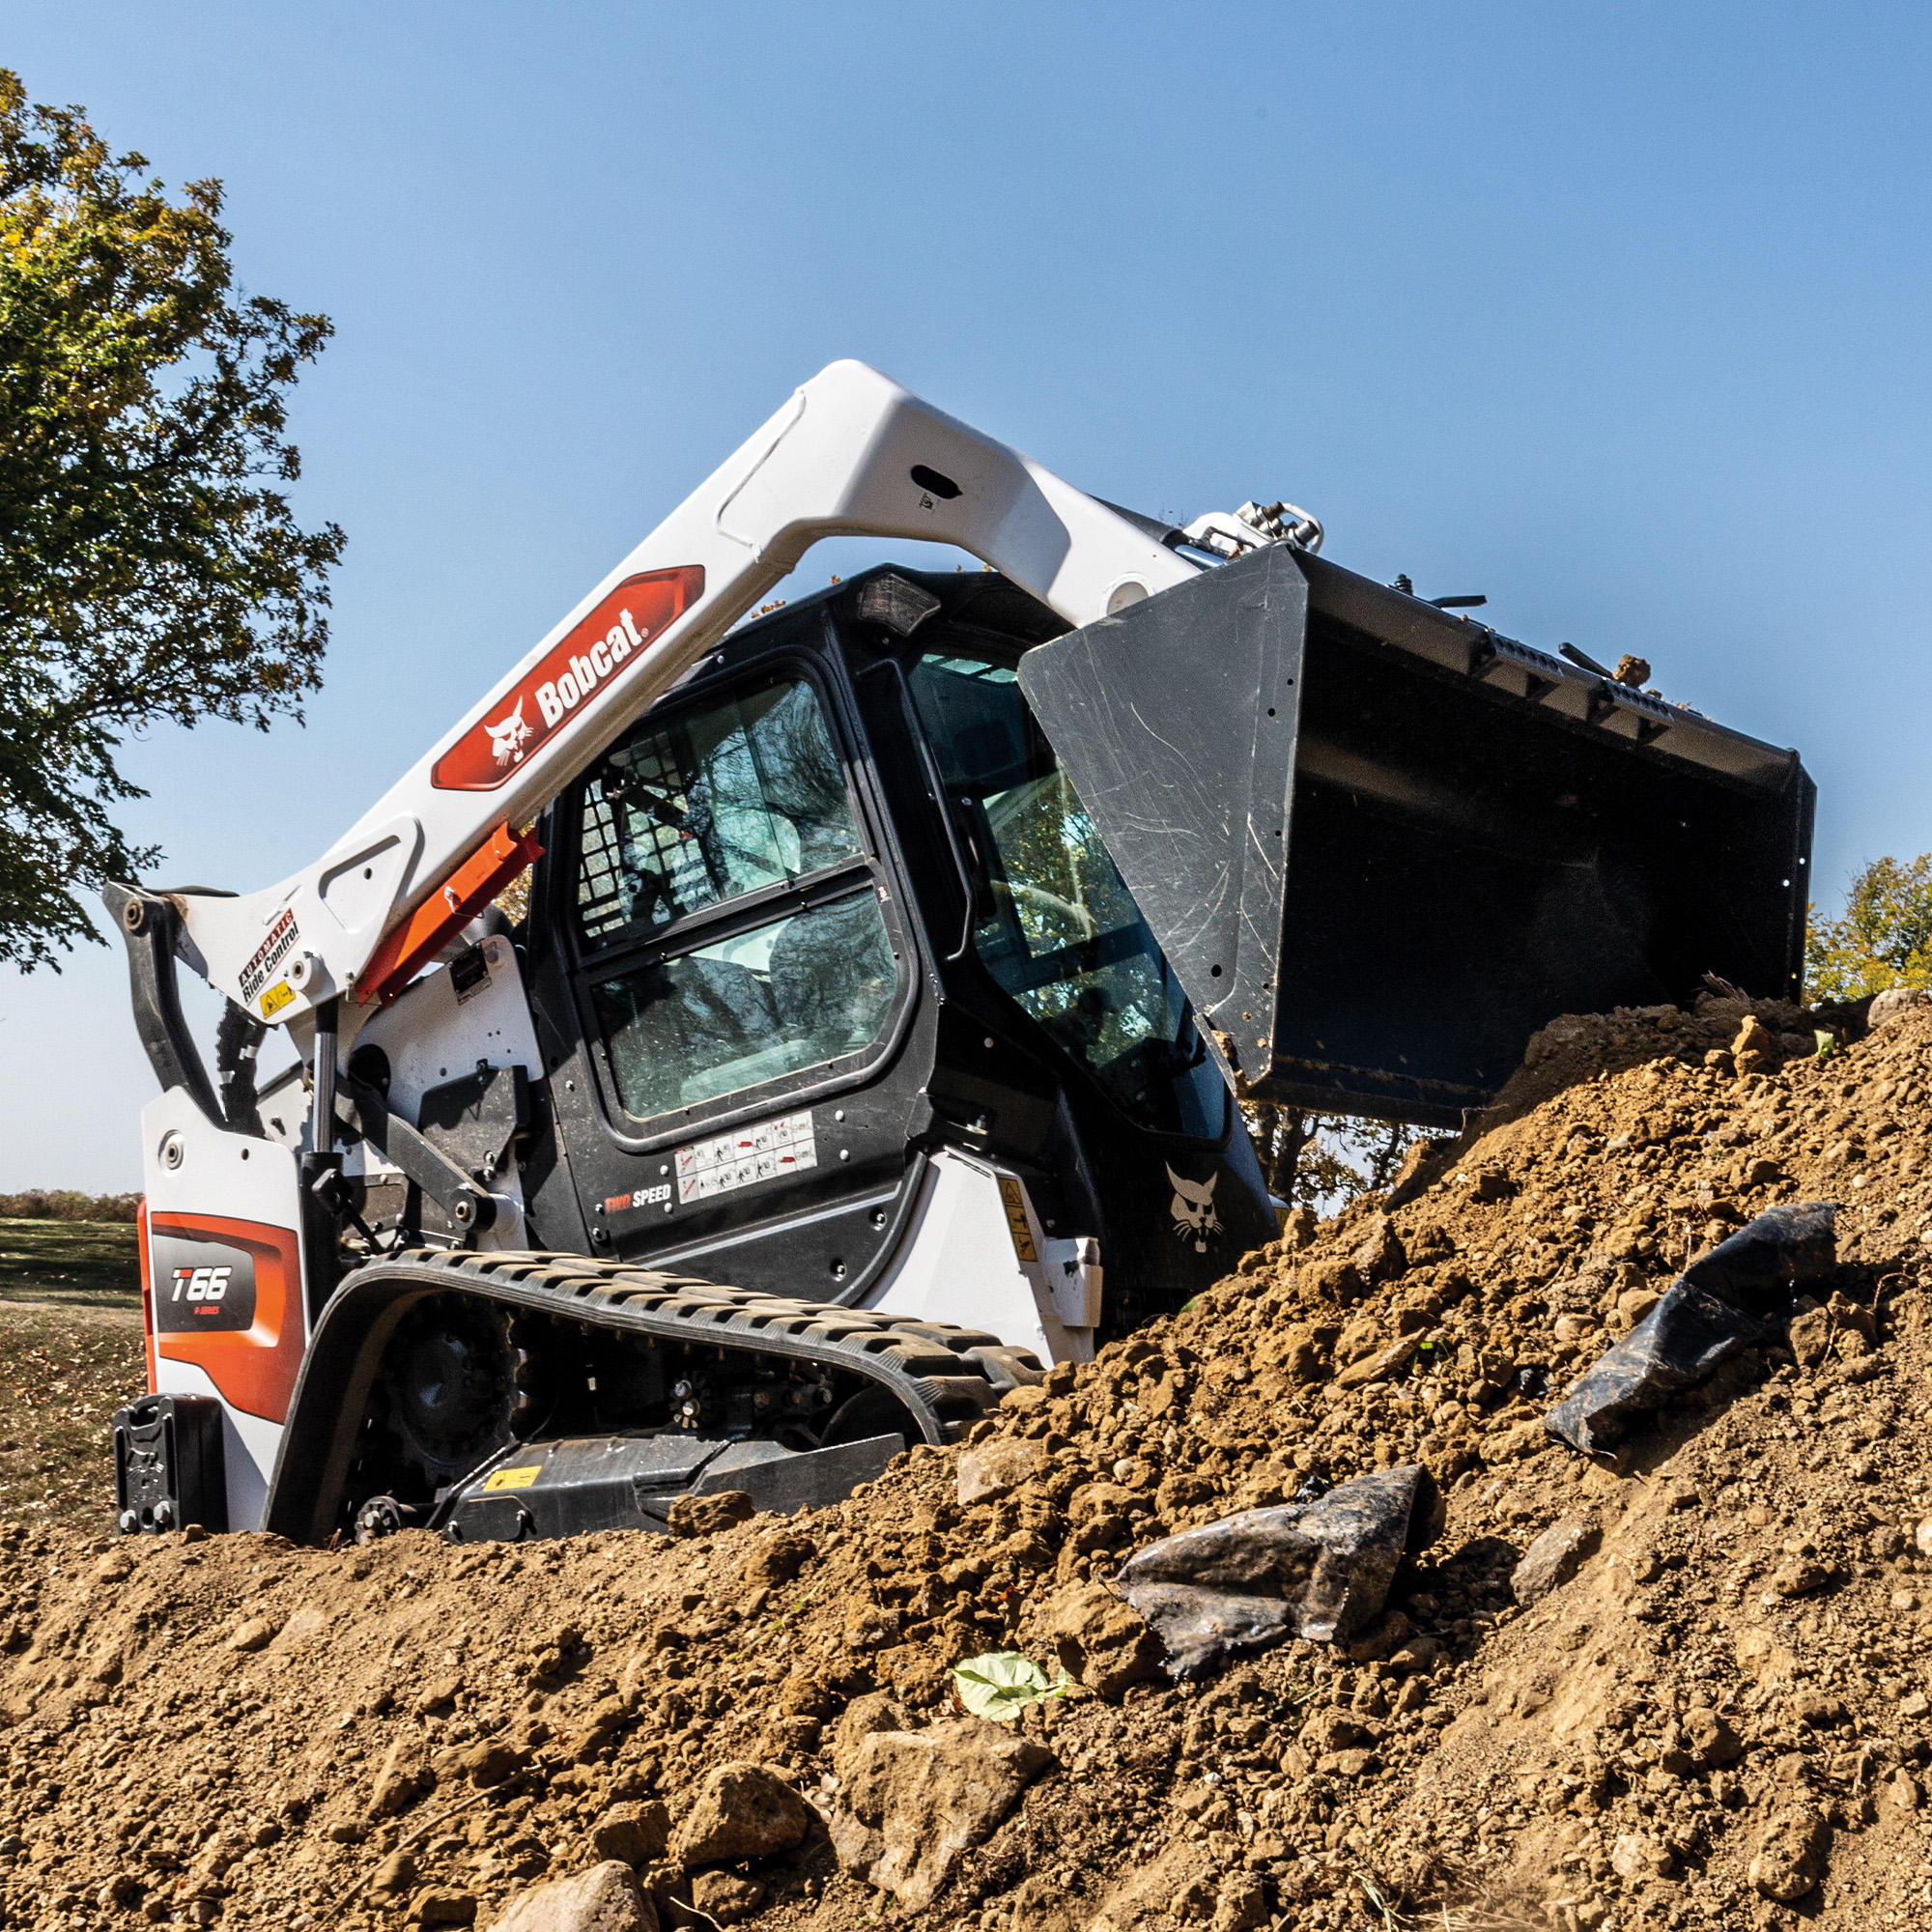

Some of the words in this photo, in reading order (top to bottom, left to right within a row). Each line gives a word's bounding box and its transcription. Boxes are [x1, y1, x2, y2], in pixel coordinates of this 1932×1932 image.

[535, 609, 642, 727] Bobcat
[242, 970, 265, 1003] Ride
[264, 921, 298, 973] Control
[633, 1184, 671, 1208] SPEED
[171, 1267, 232, 1301] T66
